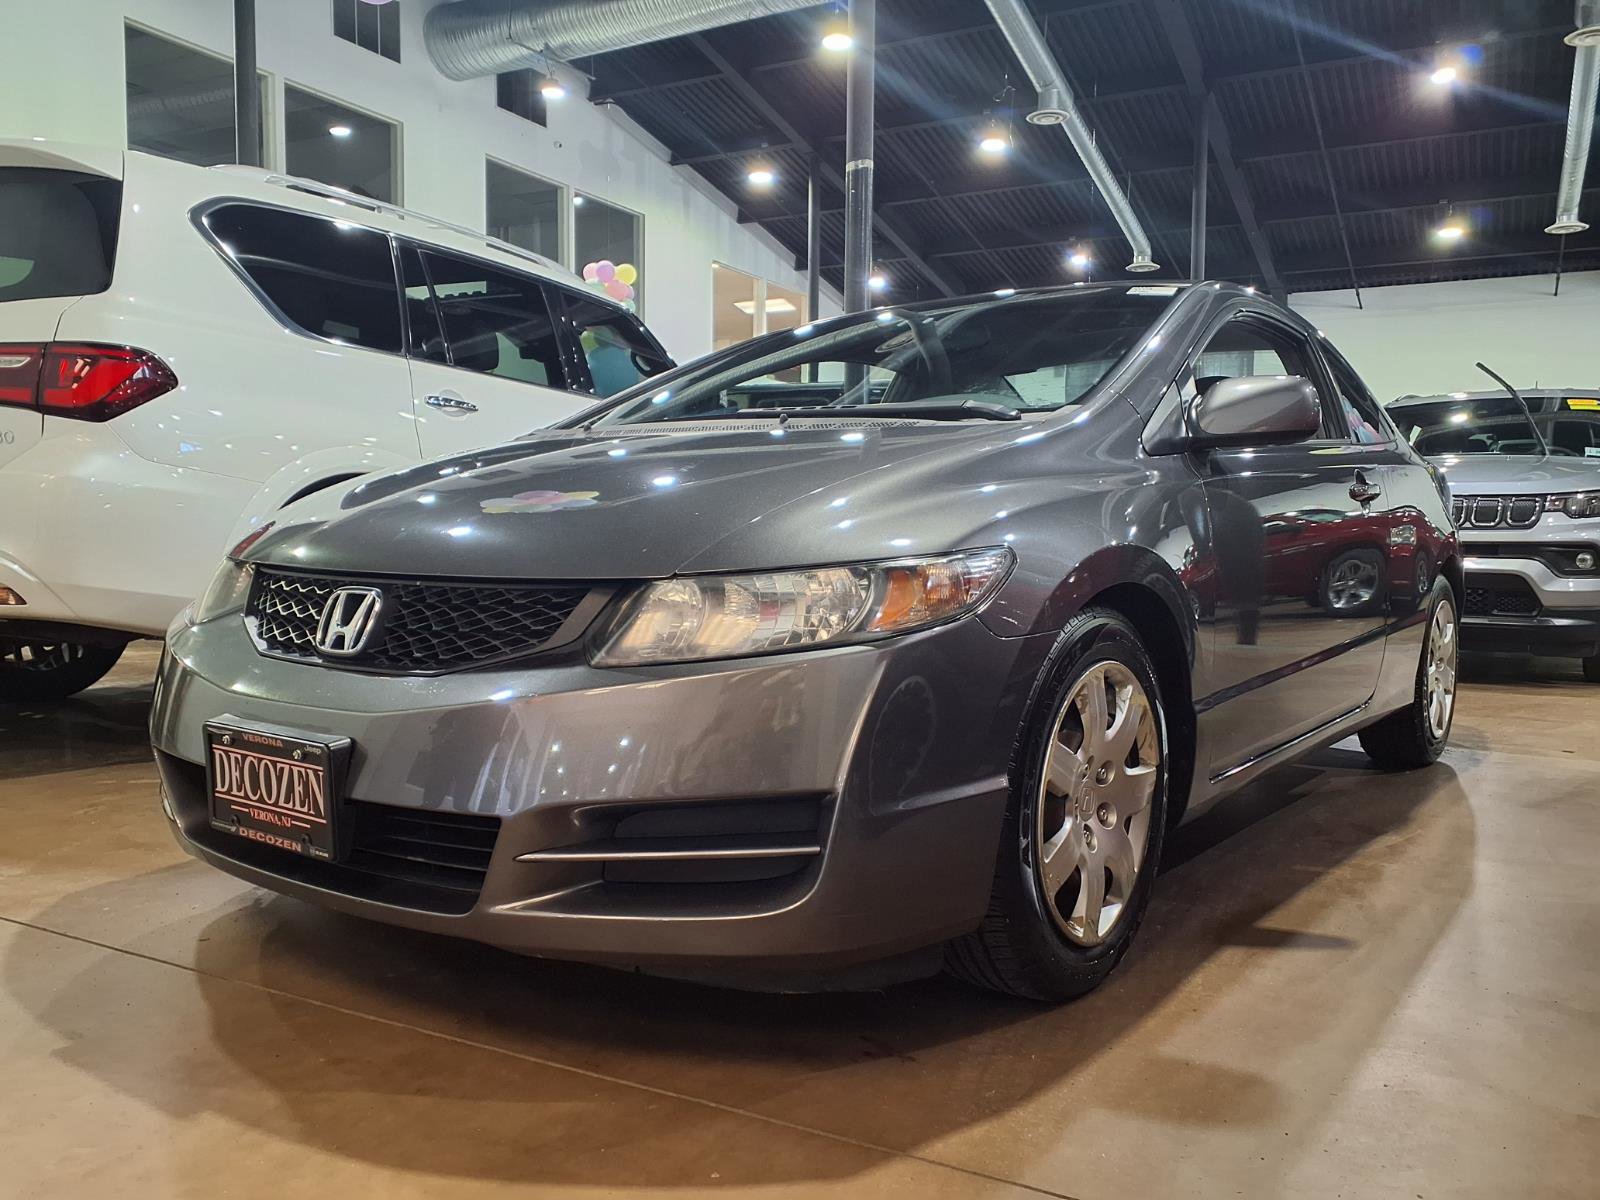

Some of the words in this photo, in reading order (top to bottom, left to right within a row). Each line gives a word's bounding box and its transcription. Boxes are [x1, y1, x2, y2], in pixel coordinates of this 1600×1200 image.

[241, 732, 284, 748] VERONA
[303, 744, 322, 756] Jeep
[213, 748, 325, 818] DECOZEN
[248, 808, 281, 827] VERONA,
[281, 816, 292, 828] NJ
[239, 826, 302, 852] DECOZEN
